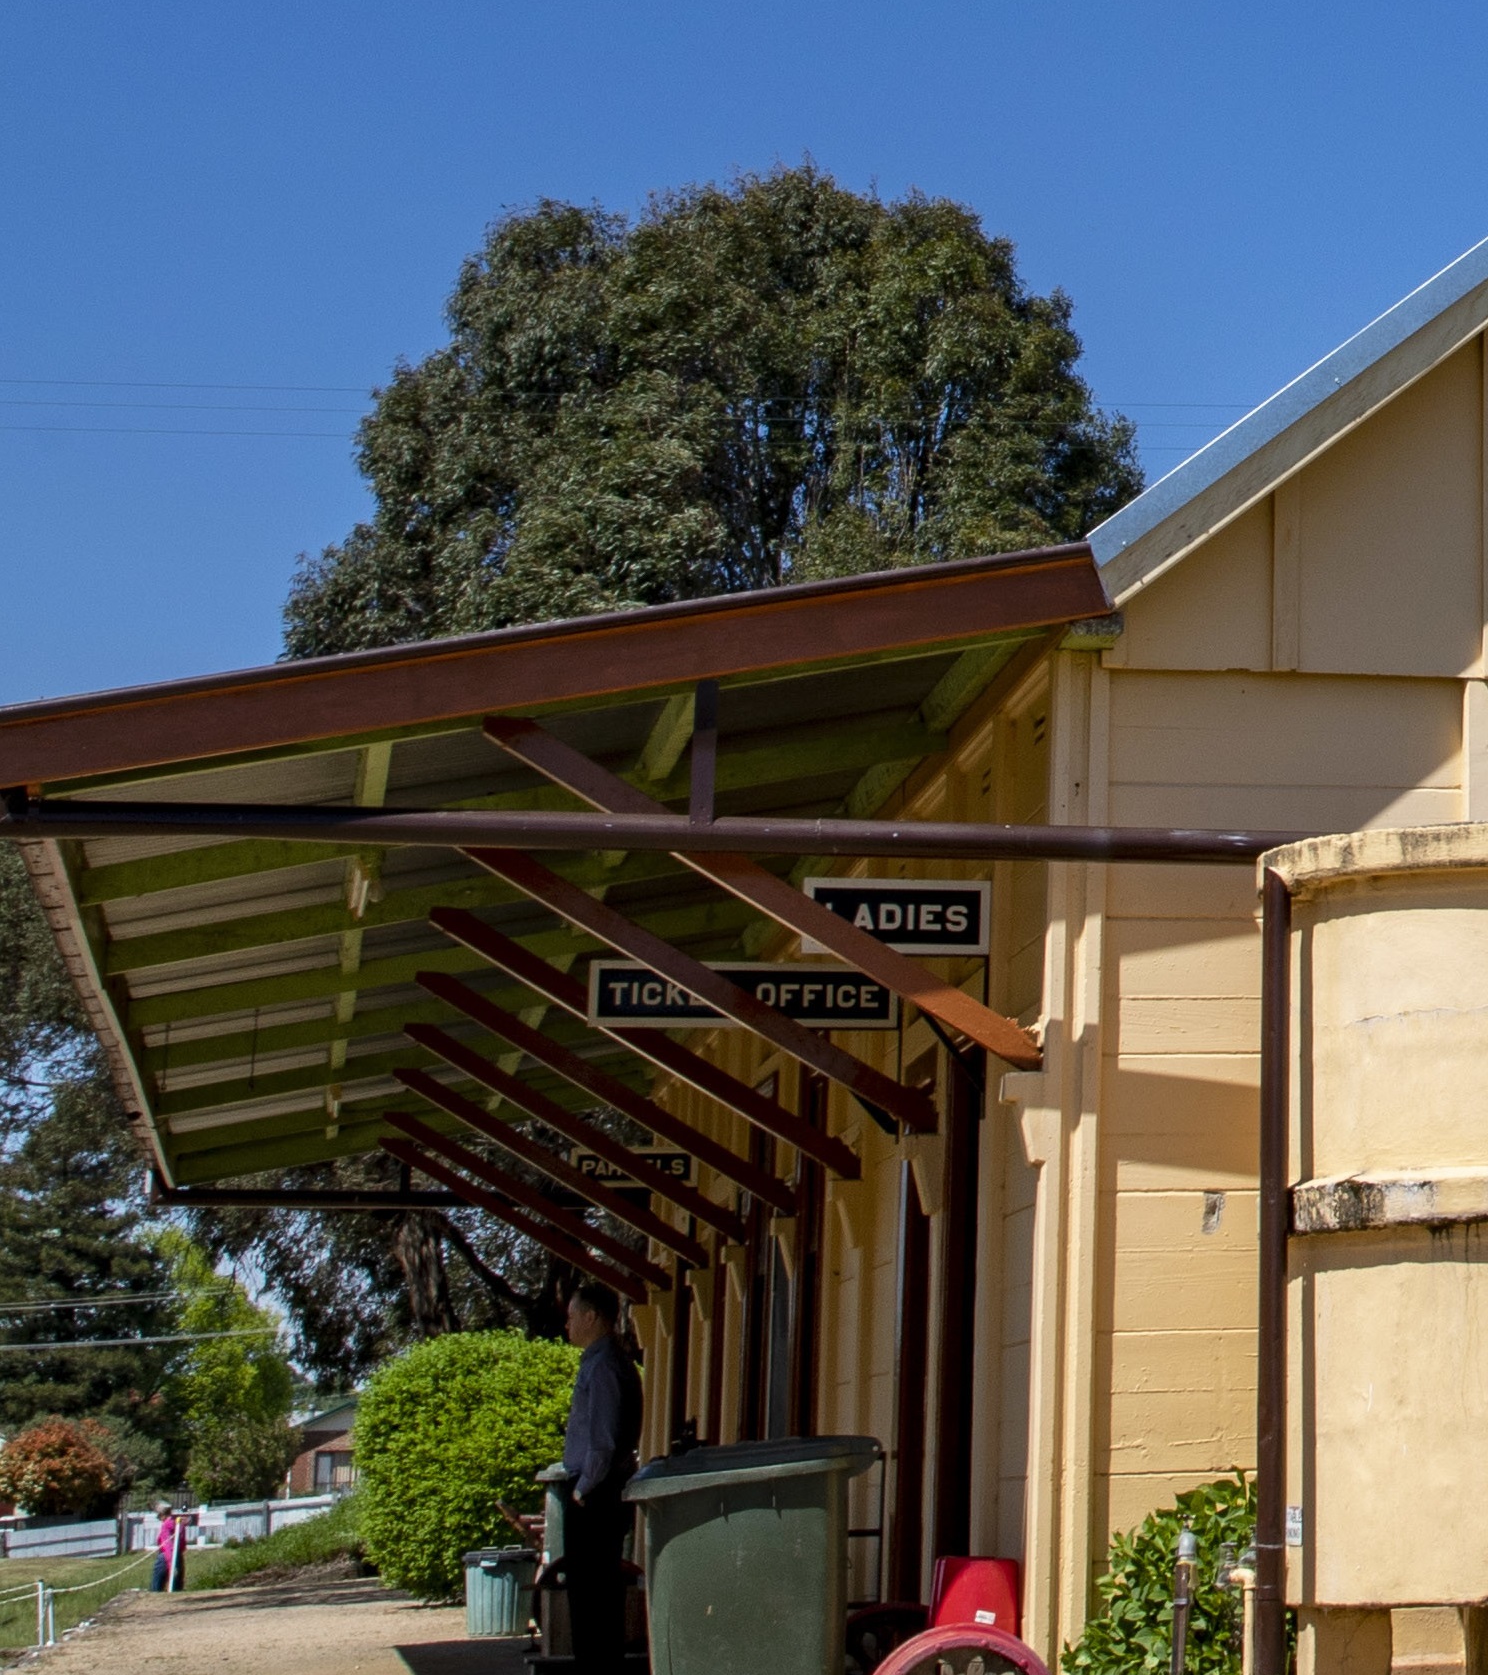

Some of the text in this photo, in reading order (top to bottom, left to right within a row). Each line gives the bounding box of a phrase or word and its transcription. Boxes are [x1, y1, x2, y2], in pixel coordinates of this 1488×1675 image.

[826, 902, 969, 933] ADIES
[608, 981, 880, 1008] TICK OFFICE
